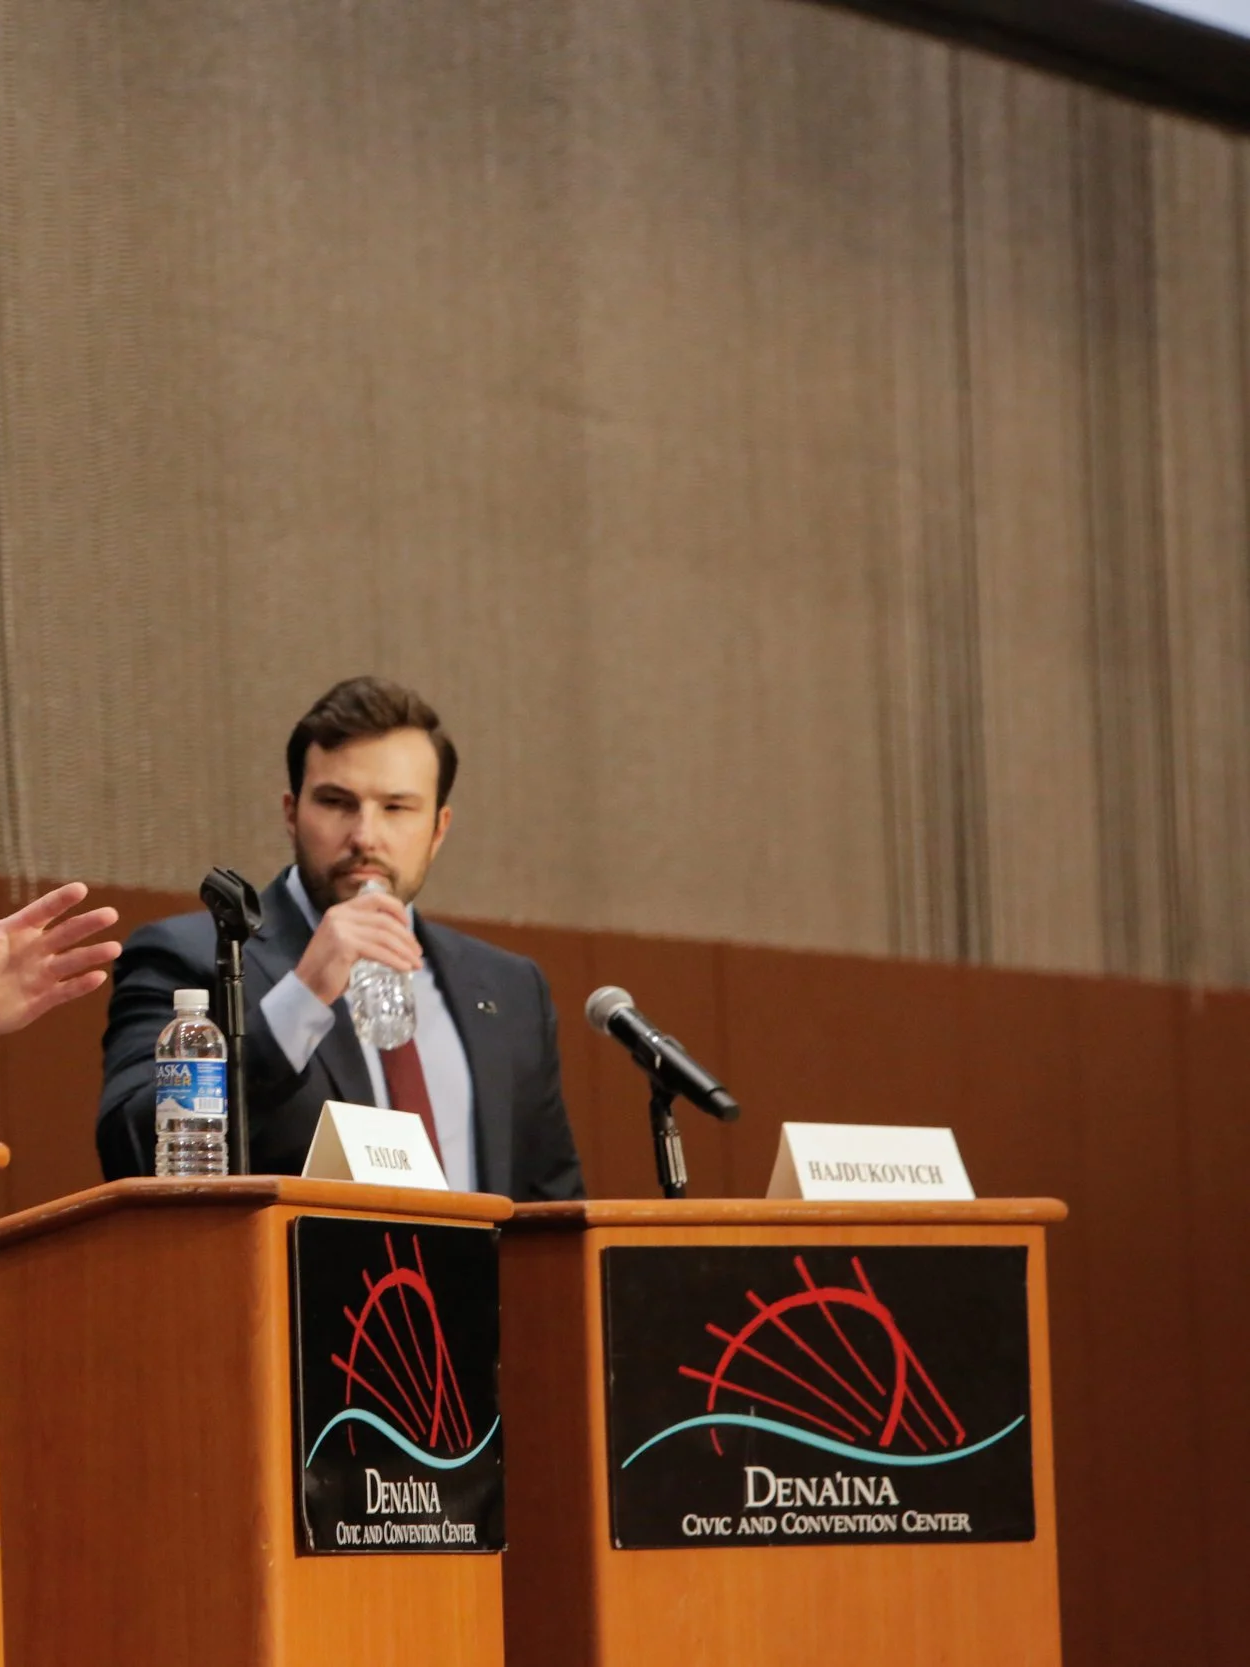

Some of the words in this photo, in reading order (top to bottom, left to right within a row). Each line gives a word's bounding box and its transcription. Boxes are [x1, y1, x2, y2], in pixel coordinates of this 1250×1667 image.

[364, 1145, 412, 1171] TAYLOR
[808, 1160, 944, 1185] HAJDUKOVICH
[336, 1521, 361, 1545] CIVIC
[363, 1524, 383, 1544] AND
[383, 1521, 441, 1544] CONVENTION
[442, 1520, 477, 1544] CENTER
[682, 1514, 732, 1536] CIVIC
[736, 1516, 777, 1535] AND
[781, 1511, 898, 1534] CONVENTION
[901, 1510, 972, 1533] CENTER
